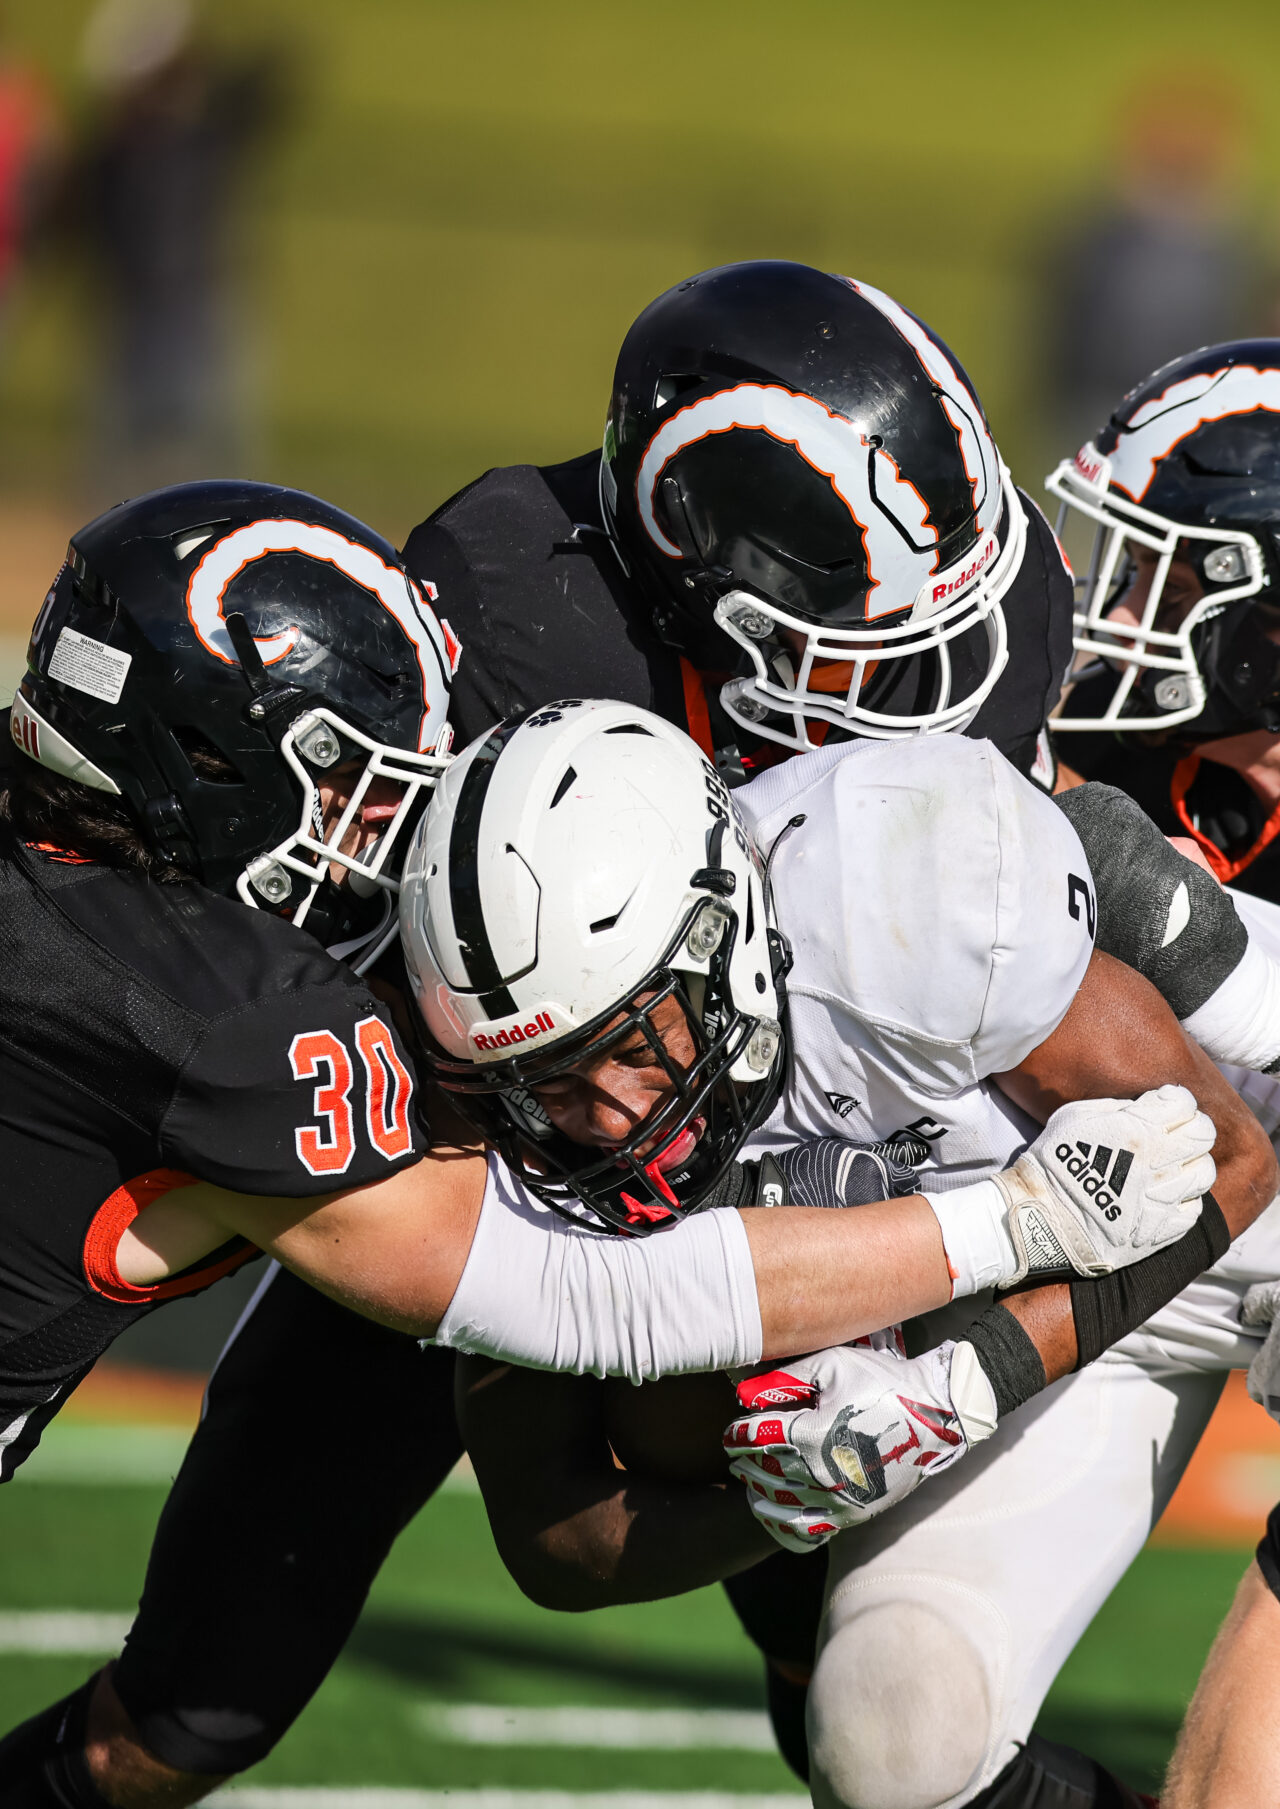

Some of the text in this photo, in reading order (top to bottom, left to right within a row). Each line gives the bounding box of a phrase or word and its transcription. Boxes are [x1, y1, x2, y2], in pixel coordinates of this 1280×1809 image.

[932, 539, 994, 604] Riddell
[79, 637, 105, 653] WARNING
[473, 1010, 556, 1051] Riddell
[287, 1015, 412, 1176] 30
[1055, 1143, 1122, 1222] adidas
